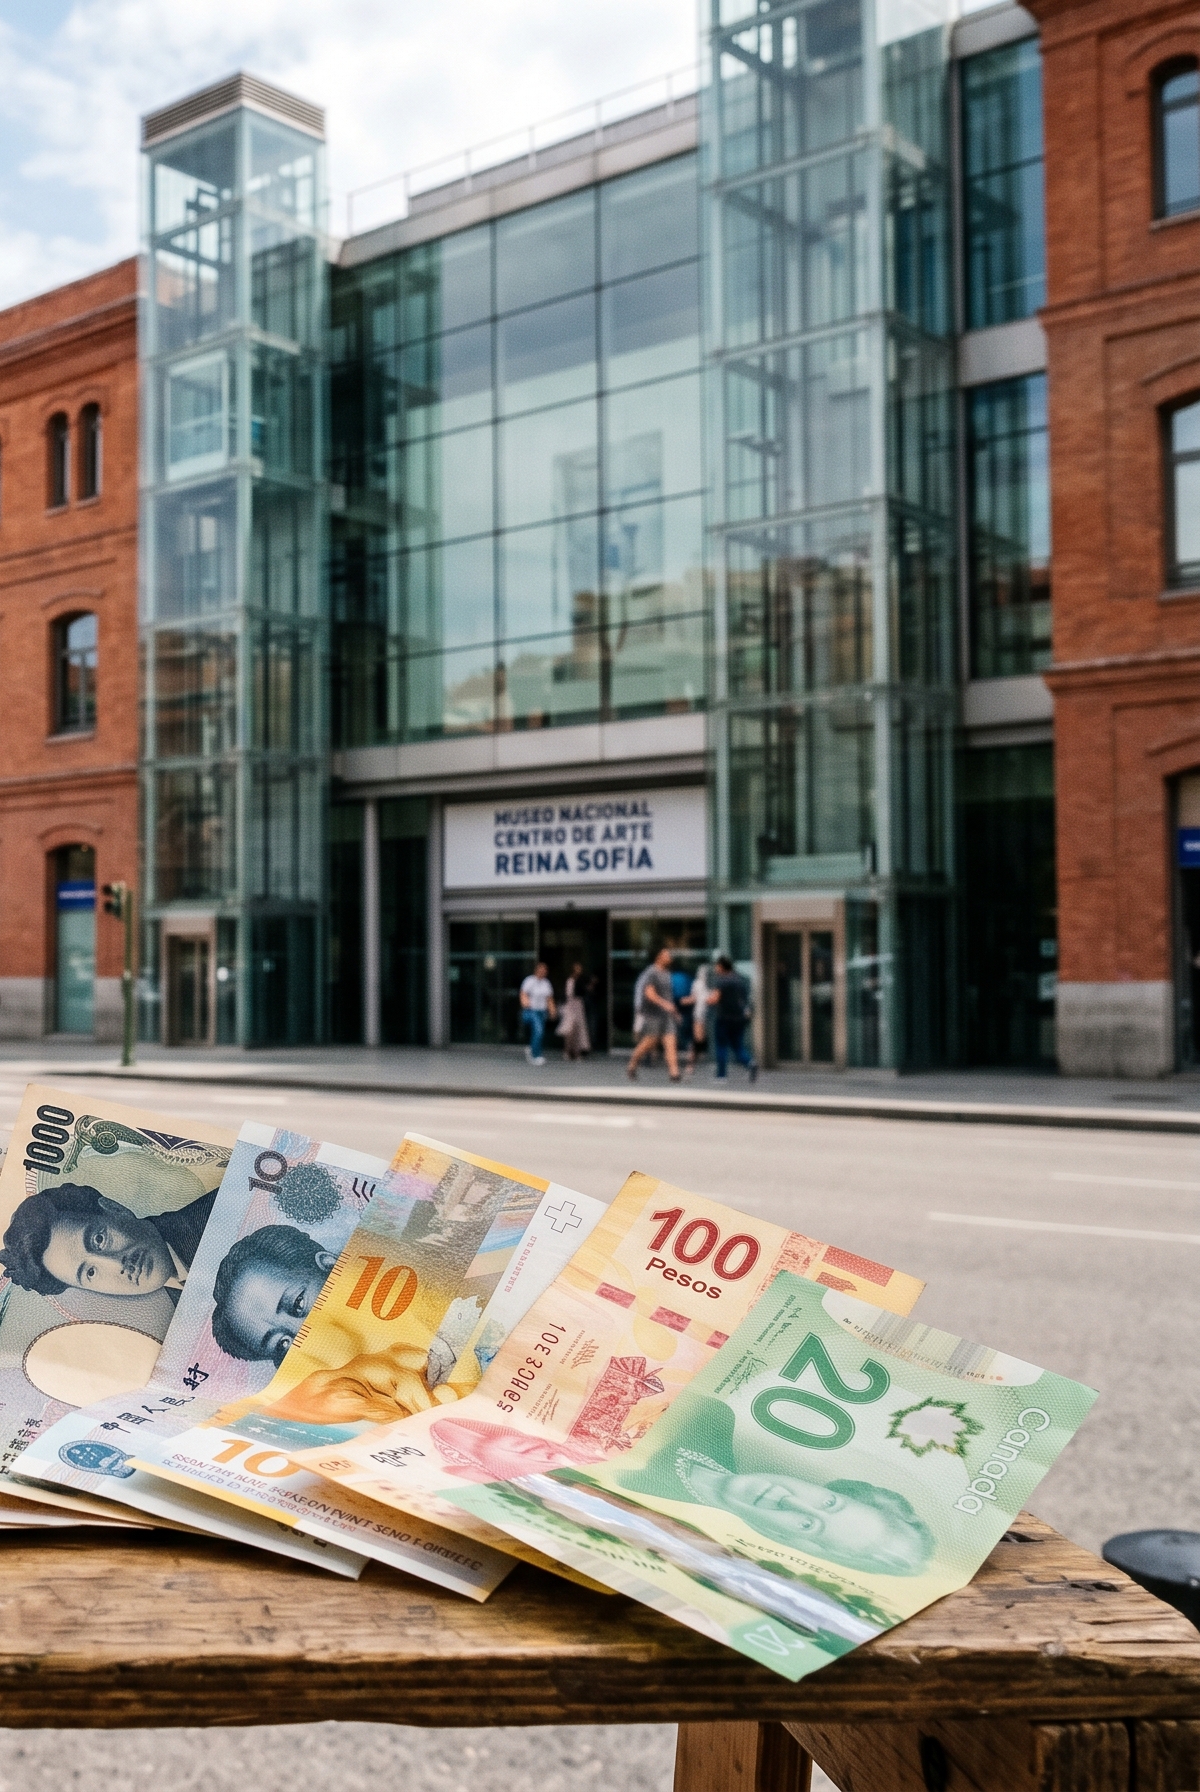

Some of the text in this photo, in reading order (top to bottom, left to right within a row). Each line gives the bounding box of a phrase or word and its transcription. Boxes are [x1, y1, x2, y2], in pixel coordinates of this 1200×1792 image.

[494, 801, 653, 826] MUSEO NACIONAL
[494, 821, 653, 848] CENTRO DE ARTE
[494, 850, 570, 876] REINA
[22, 1104, 75, 1175] 1000
[248, 1150, 288, 1195] 10
[647, 1206, 761, 1282] 100
[345, 1254, 418, 1321] 10
[645, 1256, 723, 1300] Pesos
[750, 1331, 891, 1451] 20
[210, 1438, 300, 1479] 10
[953, 1406, 1050, 1516] Canada
